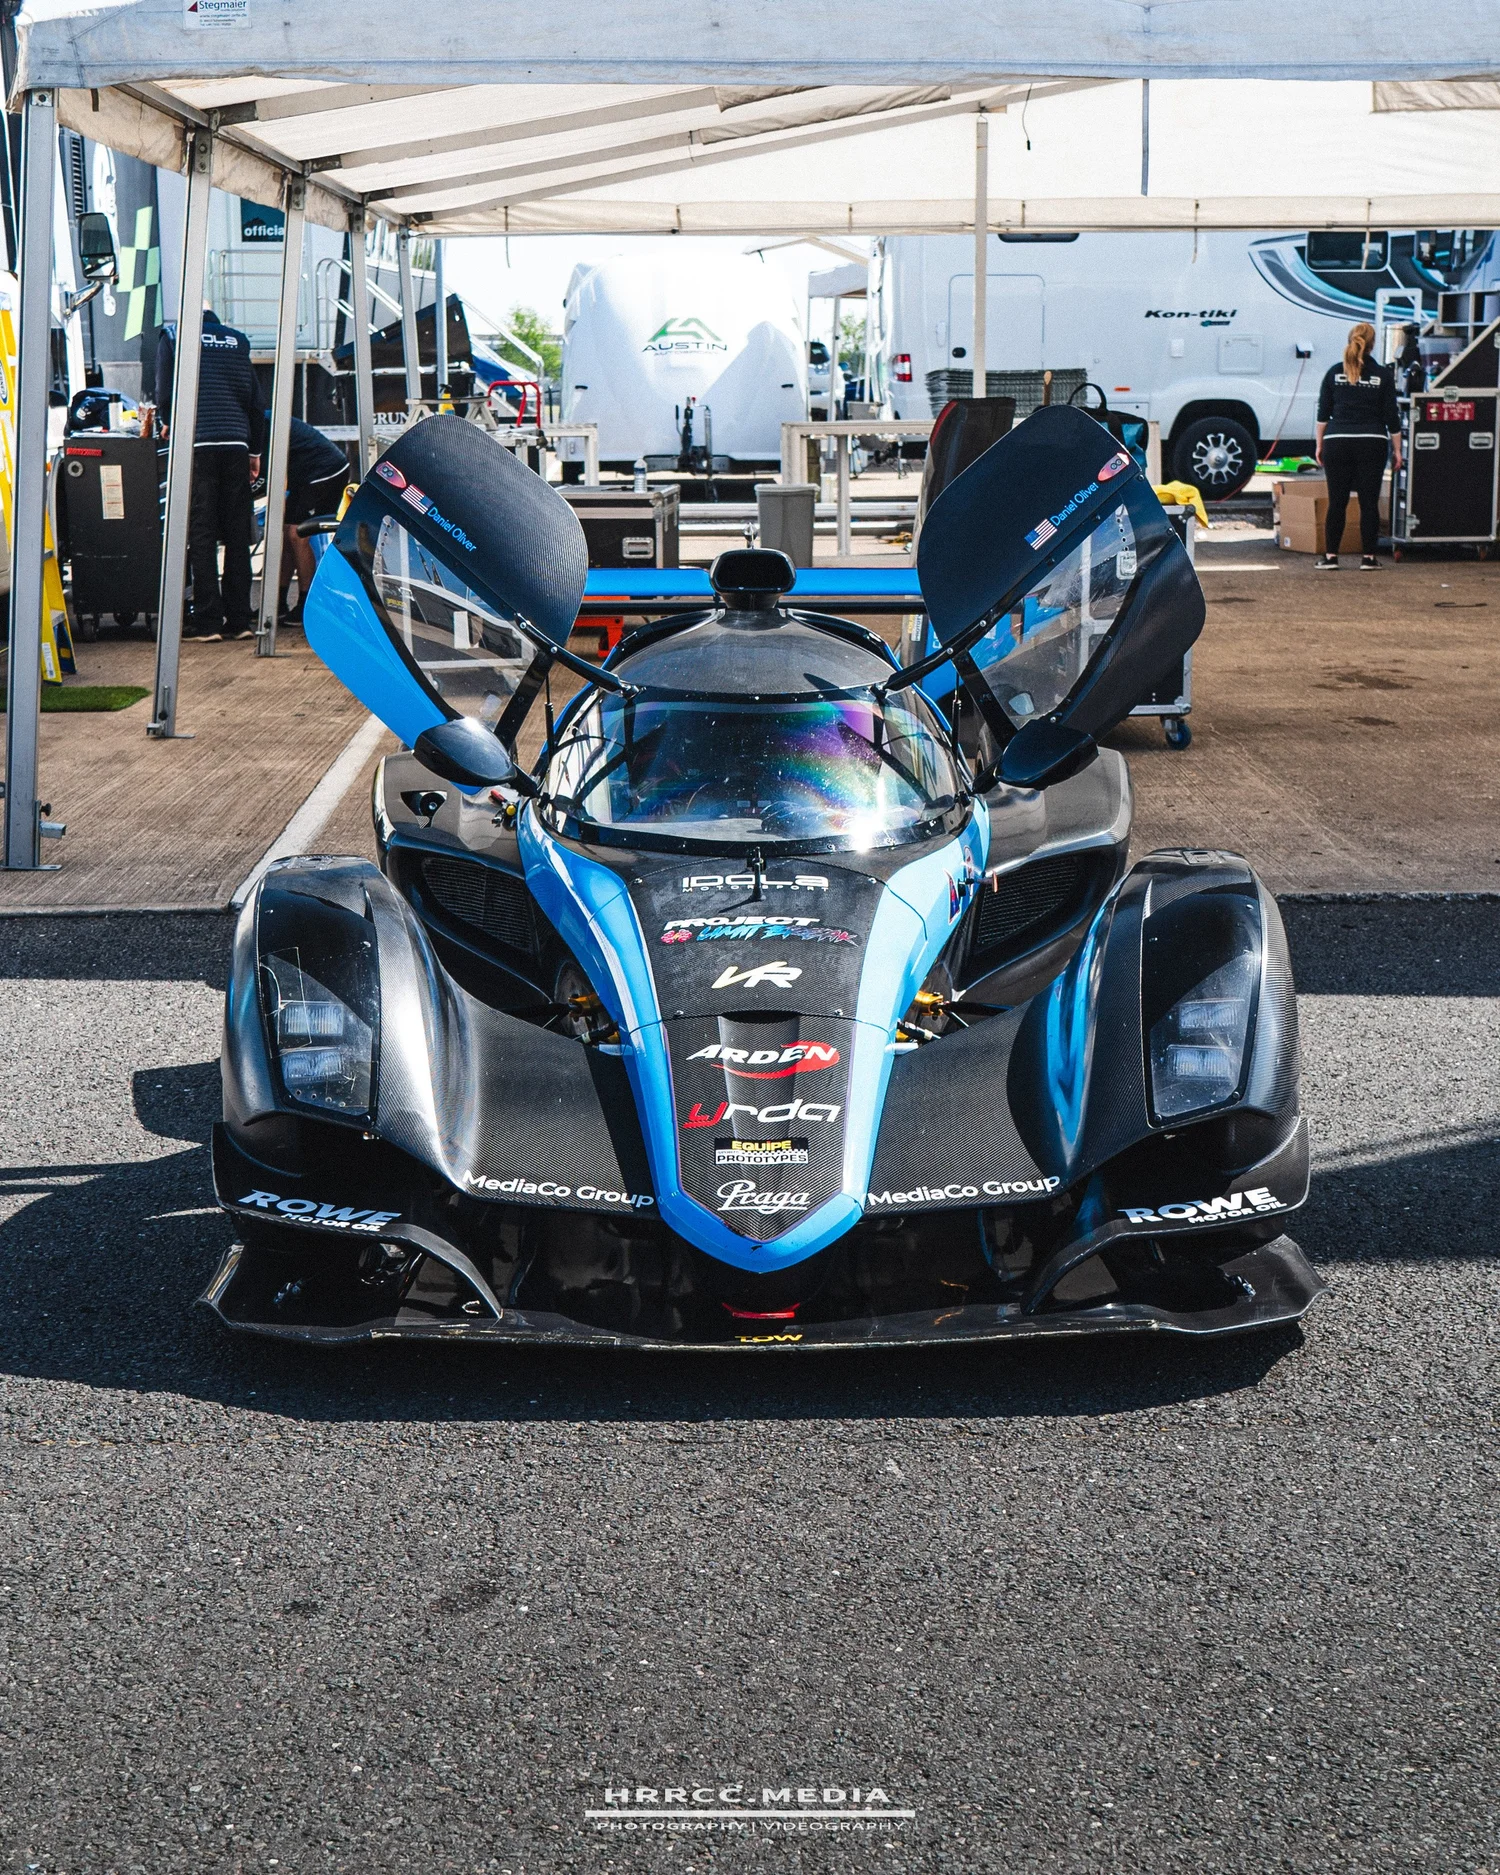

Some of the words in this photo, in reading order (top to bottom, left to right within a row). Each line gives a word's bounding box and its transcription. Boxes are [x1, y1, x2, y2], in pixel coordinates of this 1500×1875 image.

[200, 0, 247, 10] Stegmaier
[244, 224, 284, 236] officia
[1144, 309, 1237, 318] Kon-tiki
[642, 342, 727, 352] AUSTIN
[1334, 373, 1381, 386] IDLA
[1050, 500, 1078, 527] Daniel
[1074, 482, 1099, 504] Oliver
[427, 506, 454, 533] Daniel
[452, 527, 477, 552] Oliver
[682, 885, 830, 893] MOTORSPORT
[664, 916, 820, 931] PROJECT
[686, 1044, 837, 1064] ARDEN
[717, 1153, 807, 1163] PROTOTYPES
[462, 1170, 571, 1198] MediaCo
[576, 1186, 655, 1208] Group
[716, 1179, 811, 1214] Praga
[867, 1184, 979, 1206] MediaCo
[982, 1175, 1060, 1196] Group
[238, 1189, 402, 1226] ROWE
[1117, 1187, 1278, 1224] ROWE
[1187, 1208, 1255, 1224] MOTOR
[1256, 1202, 1287, 1212] OIL
[281, 1213, 350, 1228] MOTOR
[351, 1223, 381, 1232] OIL
[735, 1334, 803, 1342] TOW
